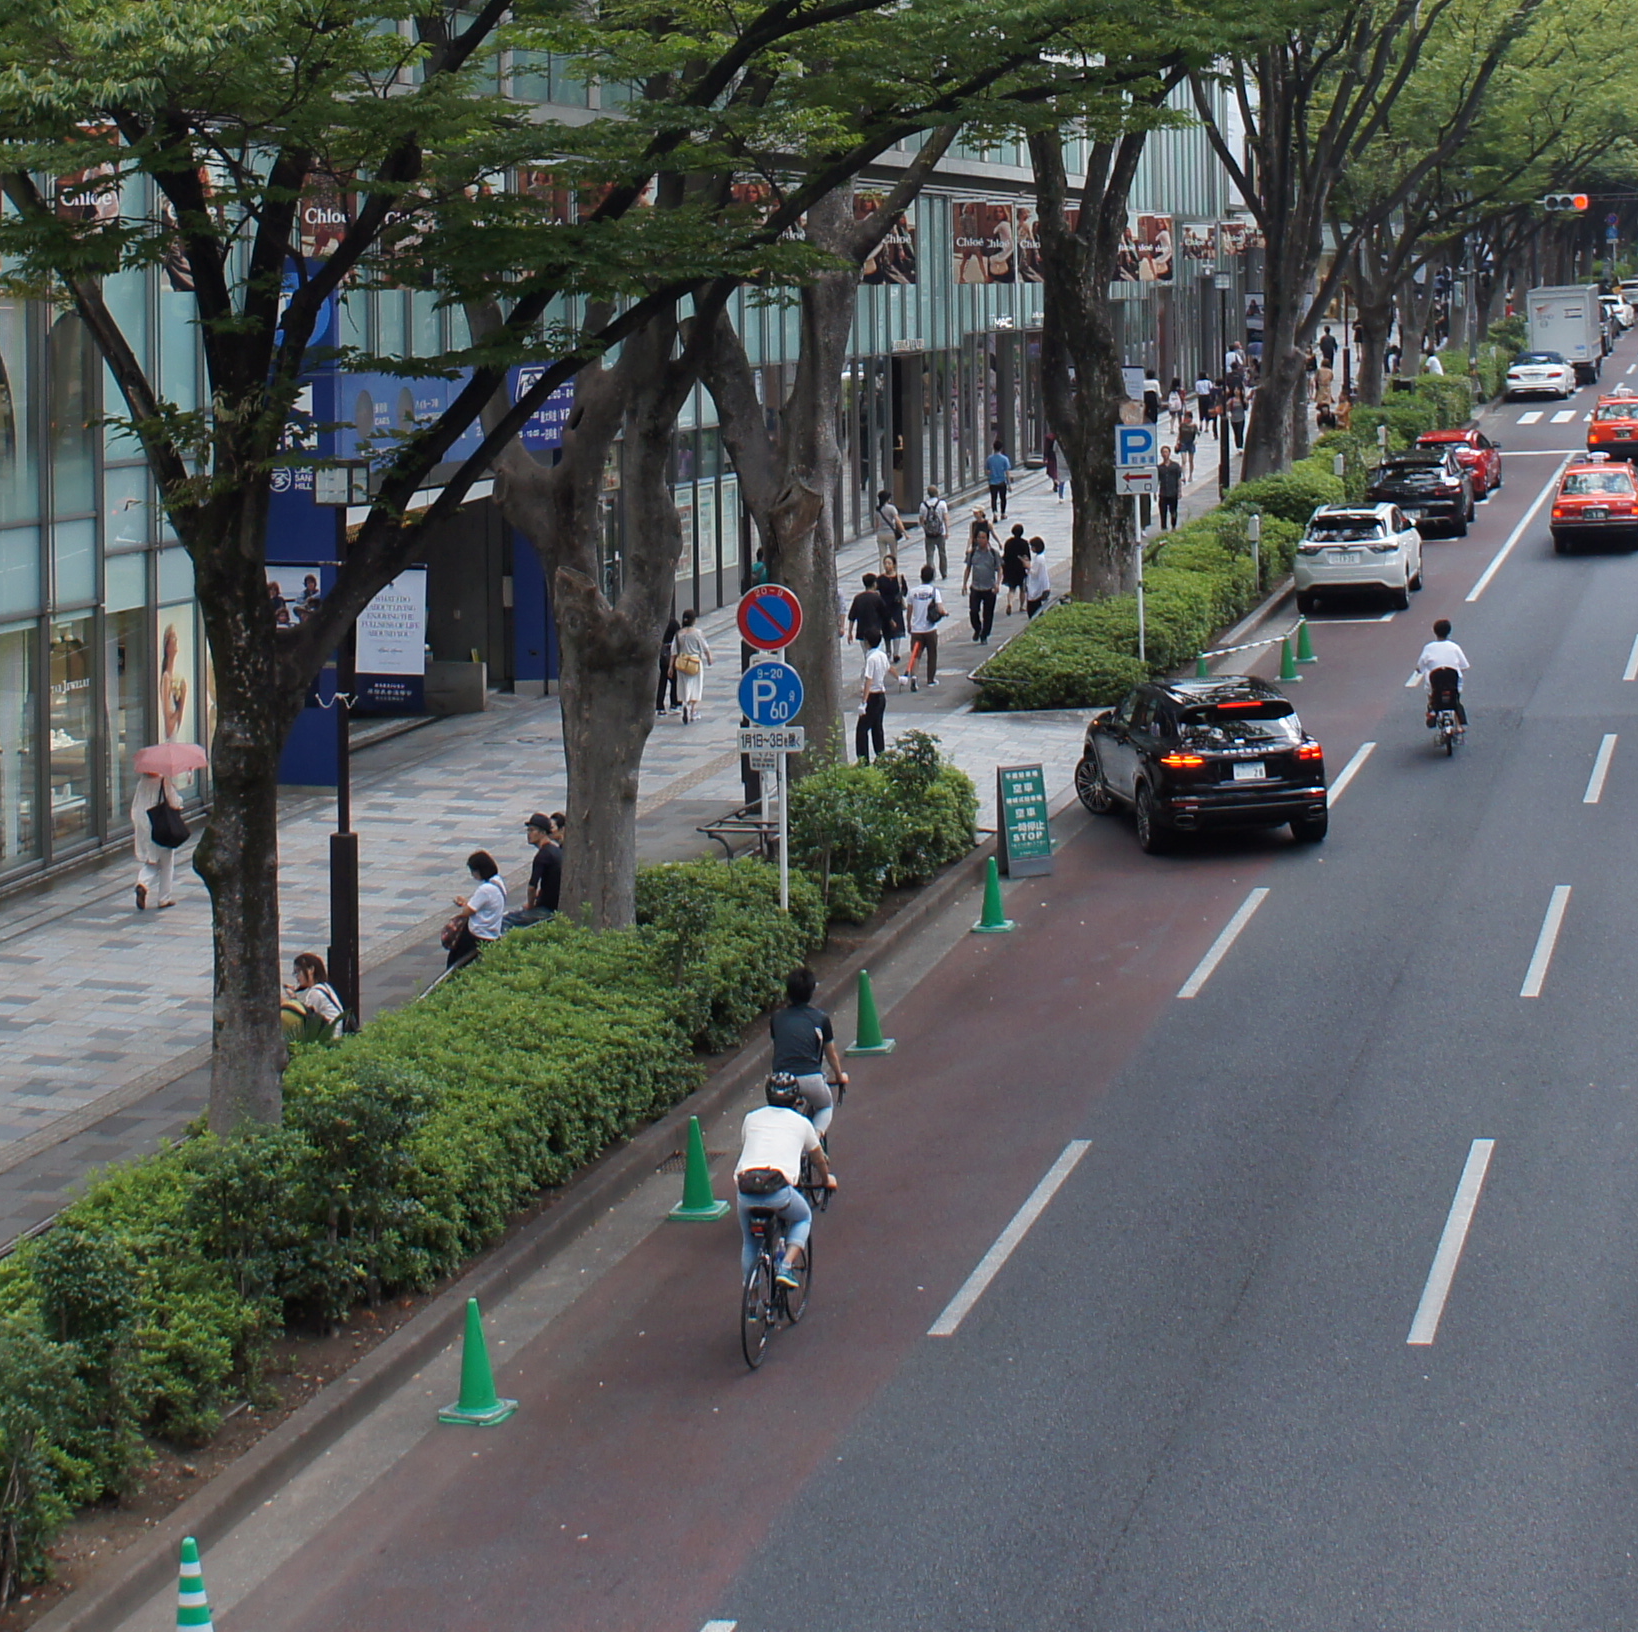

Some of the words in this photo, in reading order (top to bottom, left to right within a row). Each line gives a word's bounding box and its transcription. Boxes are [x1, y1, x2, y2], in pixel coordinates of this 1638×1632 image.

[956, 236, 984, 247] Chloé
[1120, 429, 1153, 464] P
[754, 588, 784, 598] 20-9
[757, 668, 783, 679] 9-20
[752, 679, 777, 719] P
[770, 701, 788, 719] 60
[1009, 820, 1045, 832] 一時停止
[1013, 831, 1044, 842] STOP
